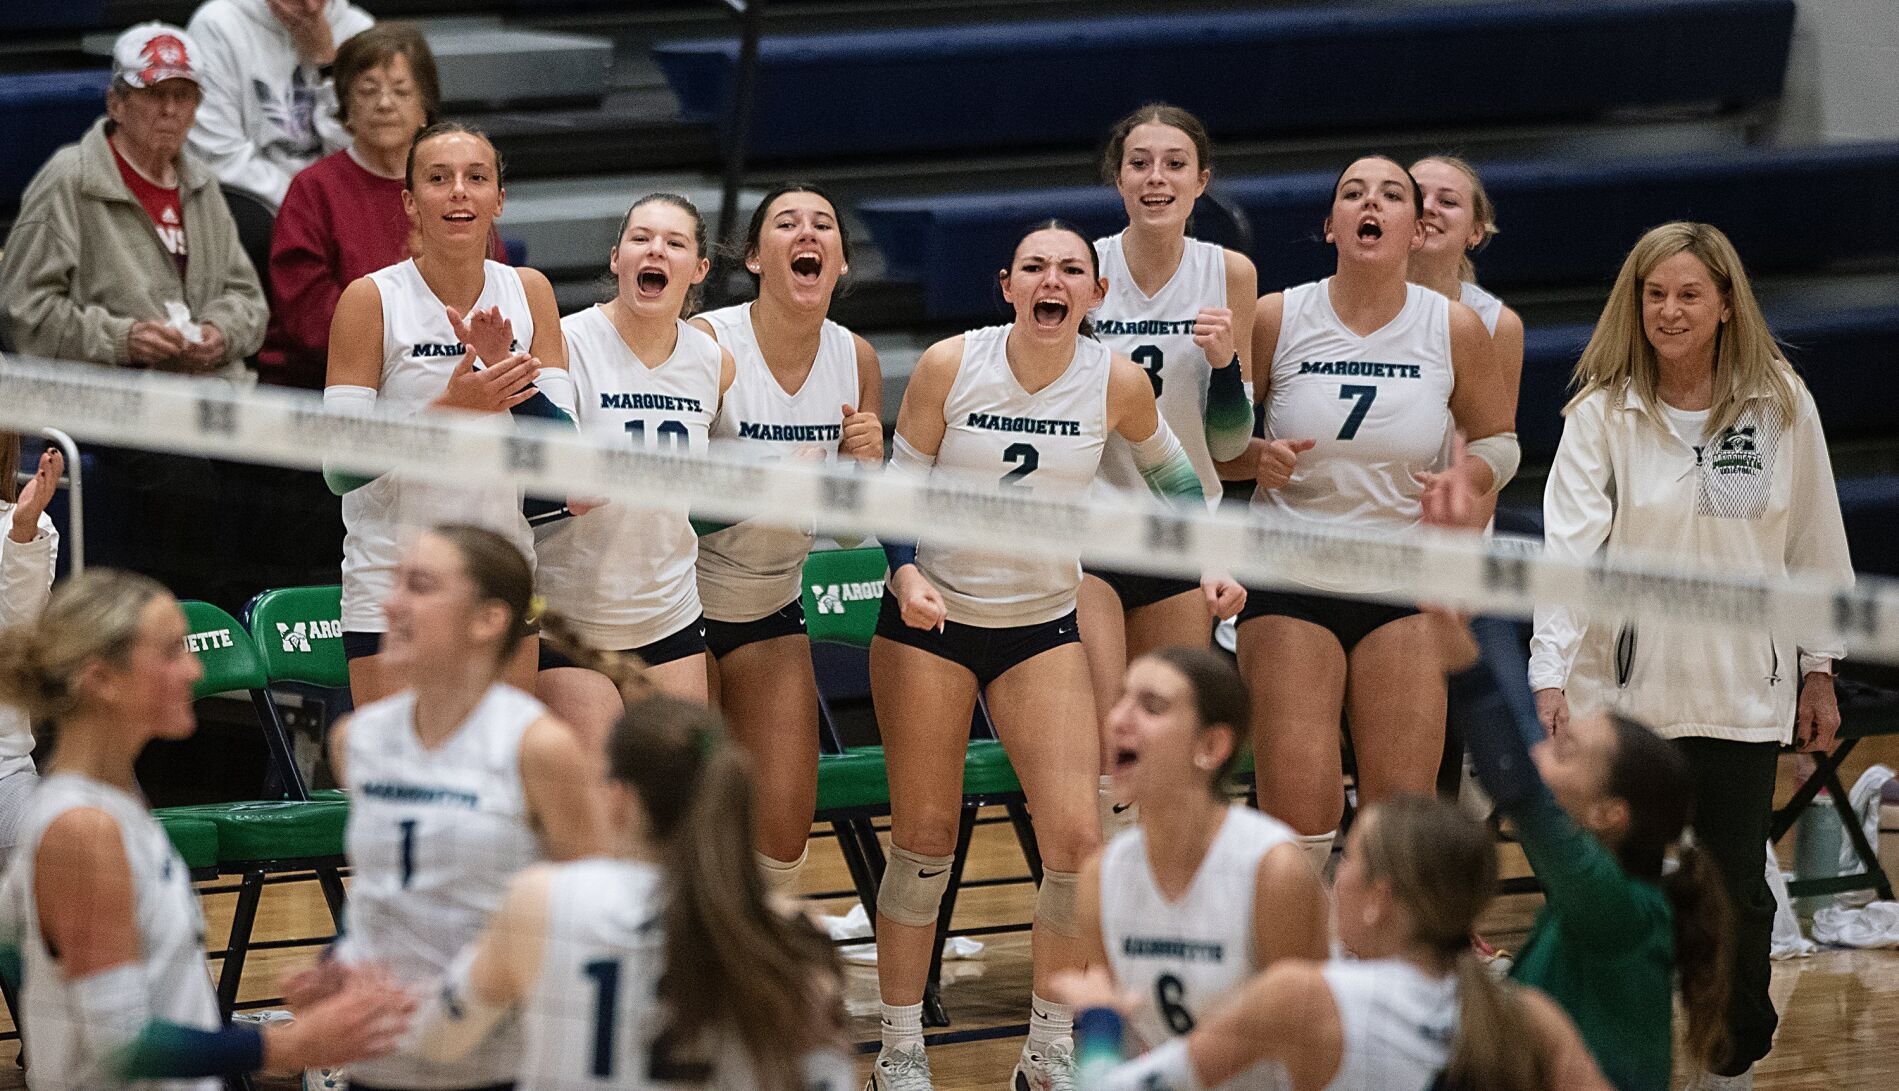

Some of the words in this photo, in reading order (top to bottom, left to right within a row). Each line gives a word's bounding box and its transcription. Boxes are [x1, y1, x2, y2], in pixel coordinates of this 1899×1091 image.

[1299, 361, 1421, 379] MARQUETTE
[600, 393, 703, 412] MARQUETTE
[1336, 384, 1377, 440] 7
[738, 421, 841, 441] MARQUETTE
[966, 413, 1081, 436] MARQUETTE
[999, 442, 1039, 491] 2
[1157, 972, 1196, 1035] 6
